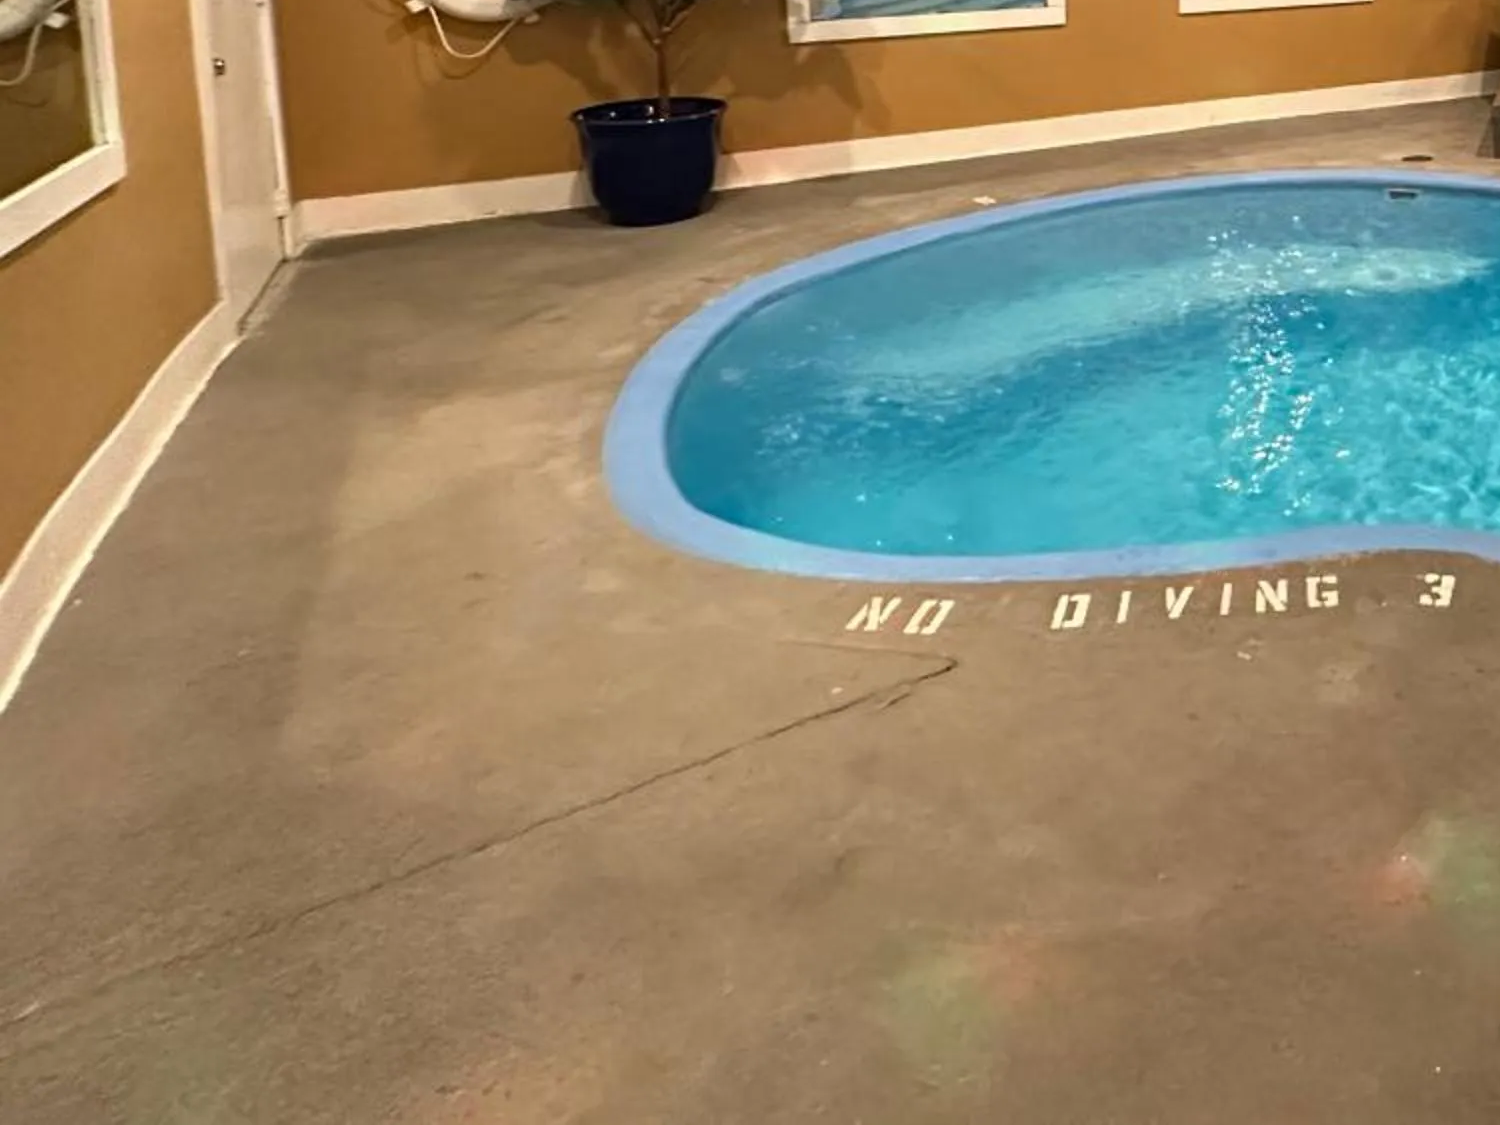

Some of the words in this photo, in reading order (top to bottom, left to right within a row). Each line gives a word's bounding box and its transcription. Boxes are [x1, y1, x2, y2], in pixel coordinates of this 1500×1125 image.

[845, 595, 956, 636] NO
[1049, 574, 1340, 630] DIVING
[1418, 573, 1456, 609] 3
